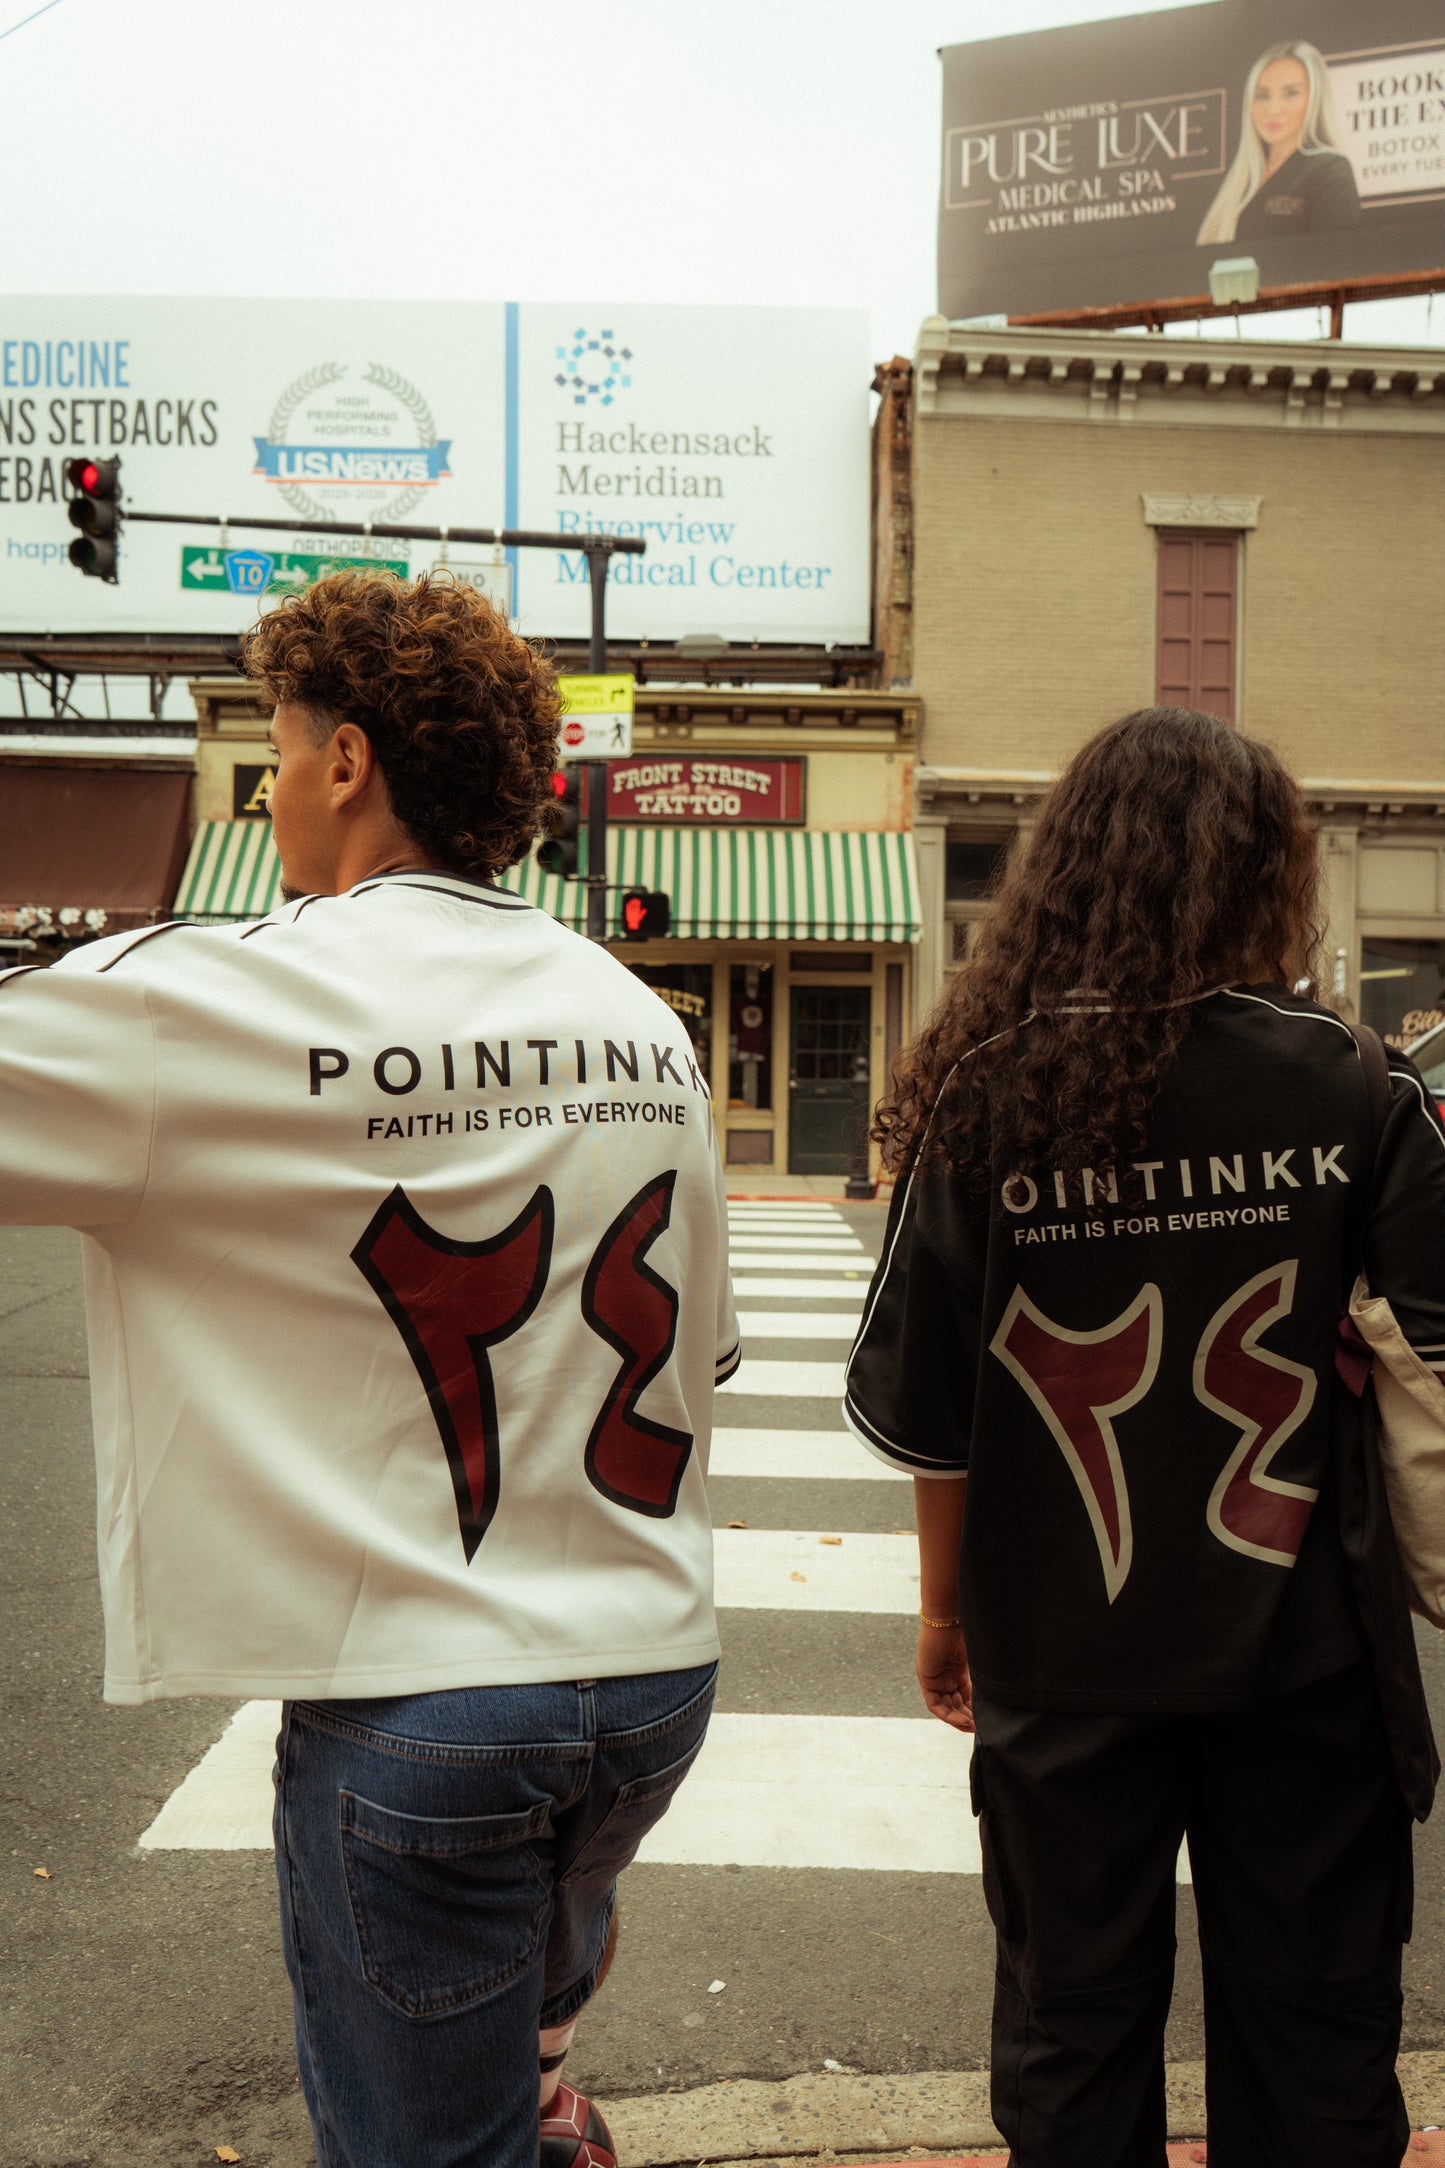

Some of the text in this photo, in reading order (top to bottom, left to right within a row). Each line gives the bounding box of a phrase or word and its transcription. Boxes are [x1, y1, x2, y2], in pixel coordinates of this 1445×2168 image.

[1347, 105, 1409, 132] THE
[961, 104, 1208, 187] PURE LUXE
[1369, 134, 1440, 158] BOTOX
[1362, 162, 1406, 179] EVERY
[1000, 169, 1165, 210] MEDICAL SPA
[985, 196, 1176, 234] ATLANTIC HIGHLANDS
[3, 341, 130, 387] EDICINE
[308, 411, 398, 421] PERFORMING
[336, 397, 369, 406] HIGH
[48, 399, 218, 445] SETBACKS
[314, 425, 391, 436] HOSPITALS
[556, 422, 772, 457] Hackensack
[556, 464, 725, 498] Meridian
[556, 511, 736, 545] Riverview
[293, 539, 411, 558] ORTHOPDICS
[239, 566, 263, 585] 10
[556, 552, 831, 589] Mdical Center
[612, 763, 772, 795] FRONT STREET
[635, 793, 741, 816] TATTOO
[367, 1102, 686, 1140] FAITH IS FOR EVERYONE
[1001, 1144, 1351, 1214] OINTINKK
[1014, 1204, 1290, 1246] FAITH IS FOR EVERYONE
